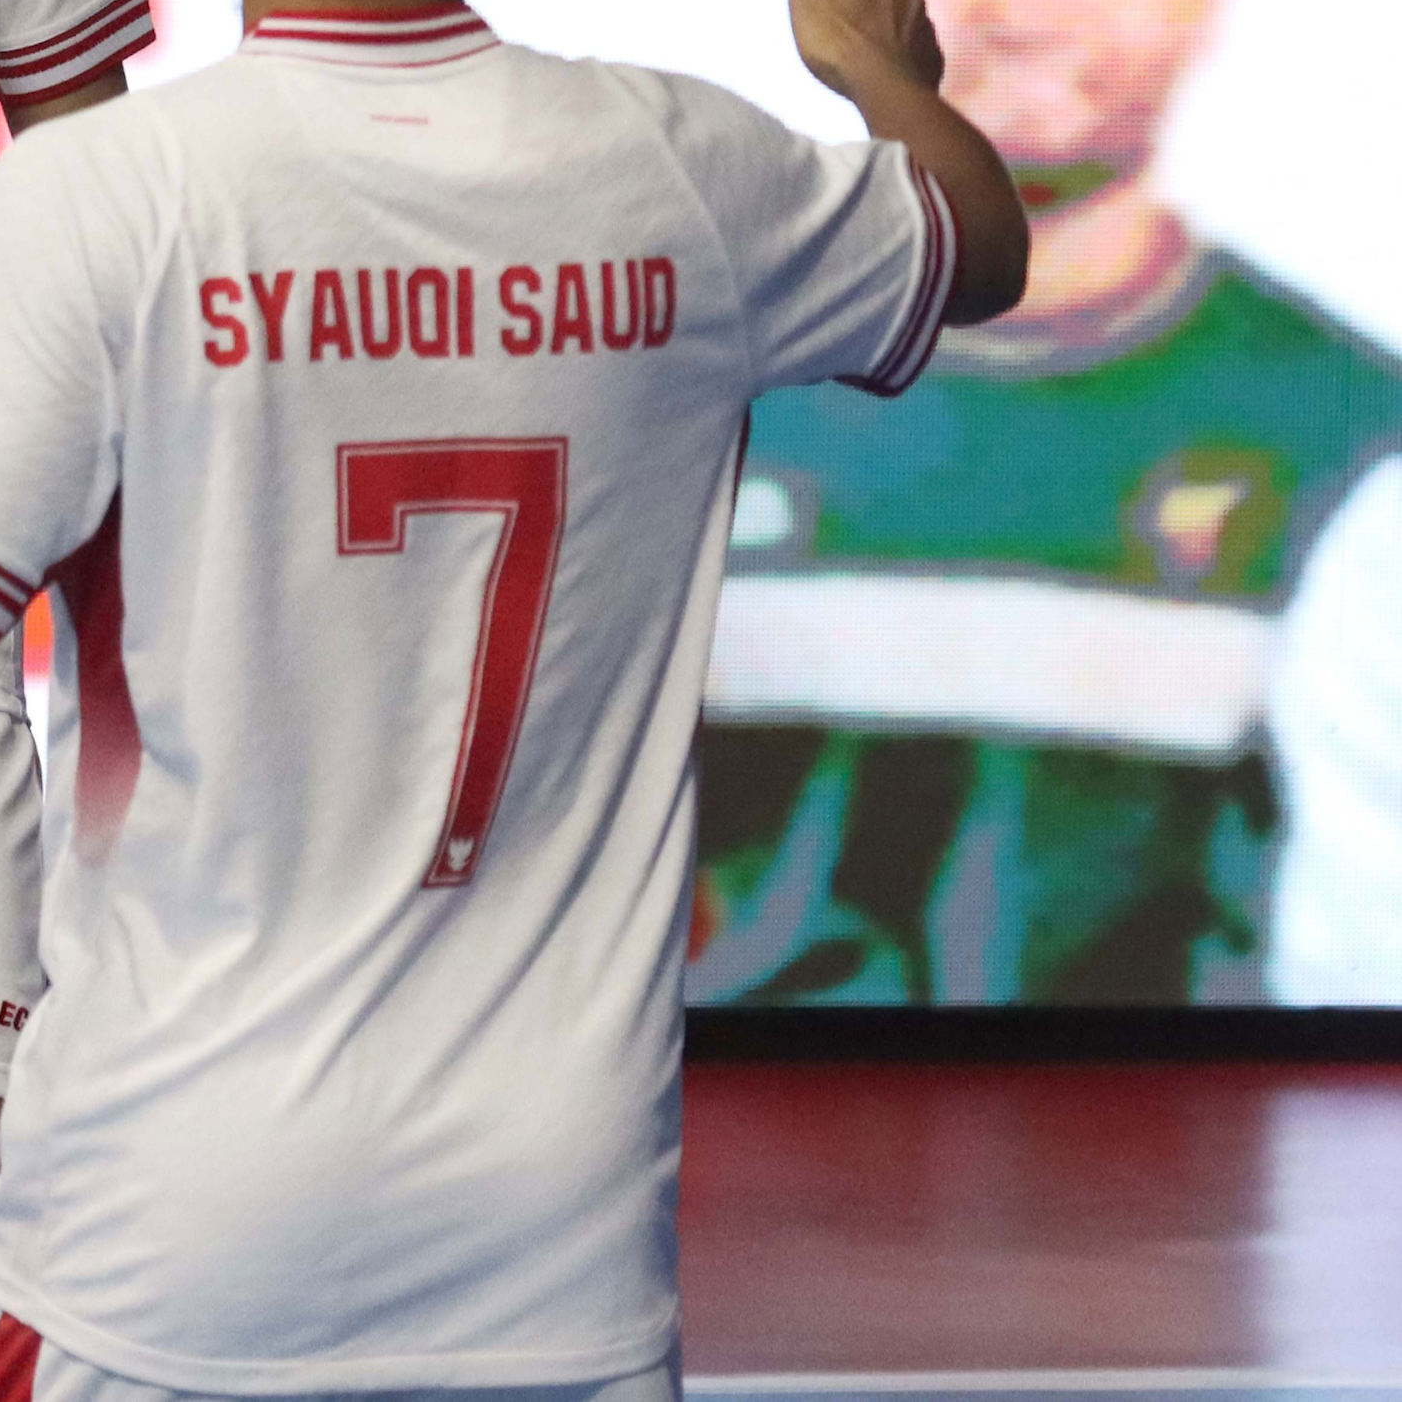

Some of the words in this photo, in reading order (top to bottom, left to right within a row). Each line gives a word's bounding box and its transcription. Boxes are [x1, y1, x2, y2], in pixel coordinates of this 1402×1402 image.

[198, 266, 475, 368] SYAUQI
[498, 256, 676, 357] SAUD
[336, 436, 569, 889] 7
